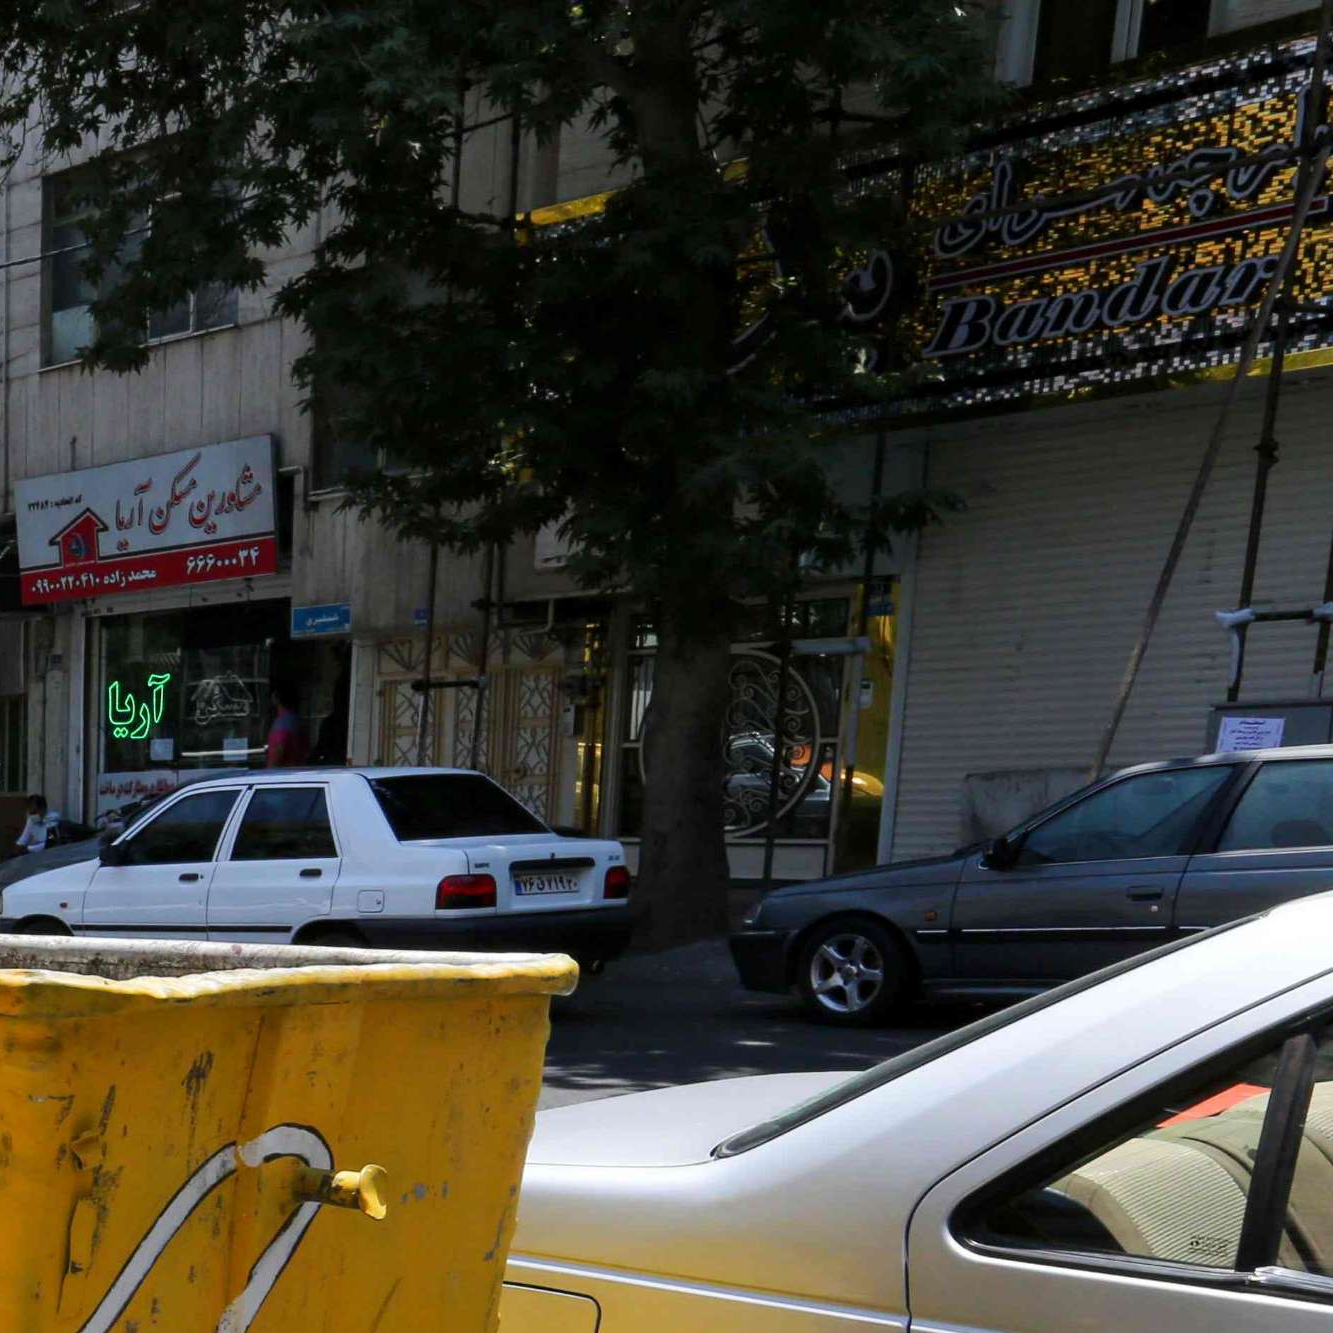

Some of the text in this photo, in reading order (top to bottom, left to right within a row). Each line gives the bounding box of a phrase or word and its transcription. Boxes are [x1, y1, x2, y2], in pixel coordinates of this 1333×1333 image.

[921, 255, 1281, 358] Bandar
[115, 451, 262, 551] مشاورین مسکن آریا
[104, 569, 126, 588] زاده
[128, 567, 157, 582] محمد
[186, 546, 261, 576] ۶۶۶۰۰۰۳۴
[108, 673, 171, 739] آریا
